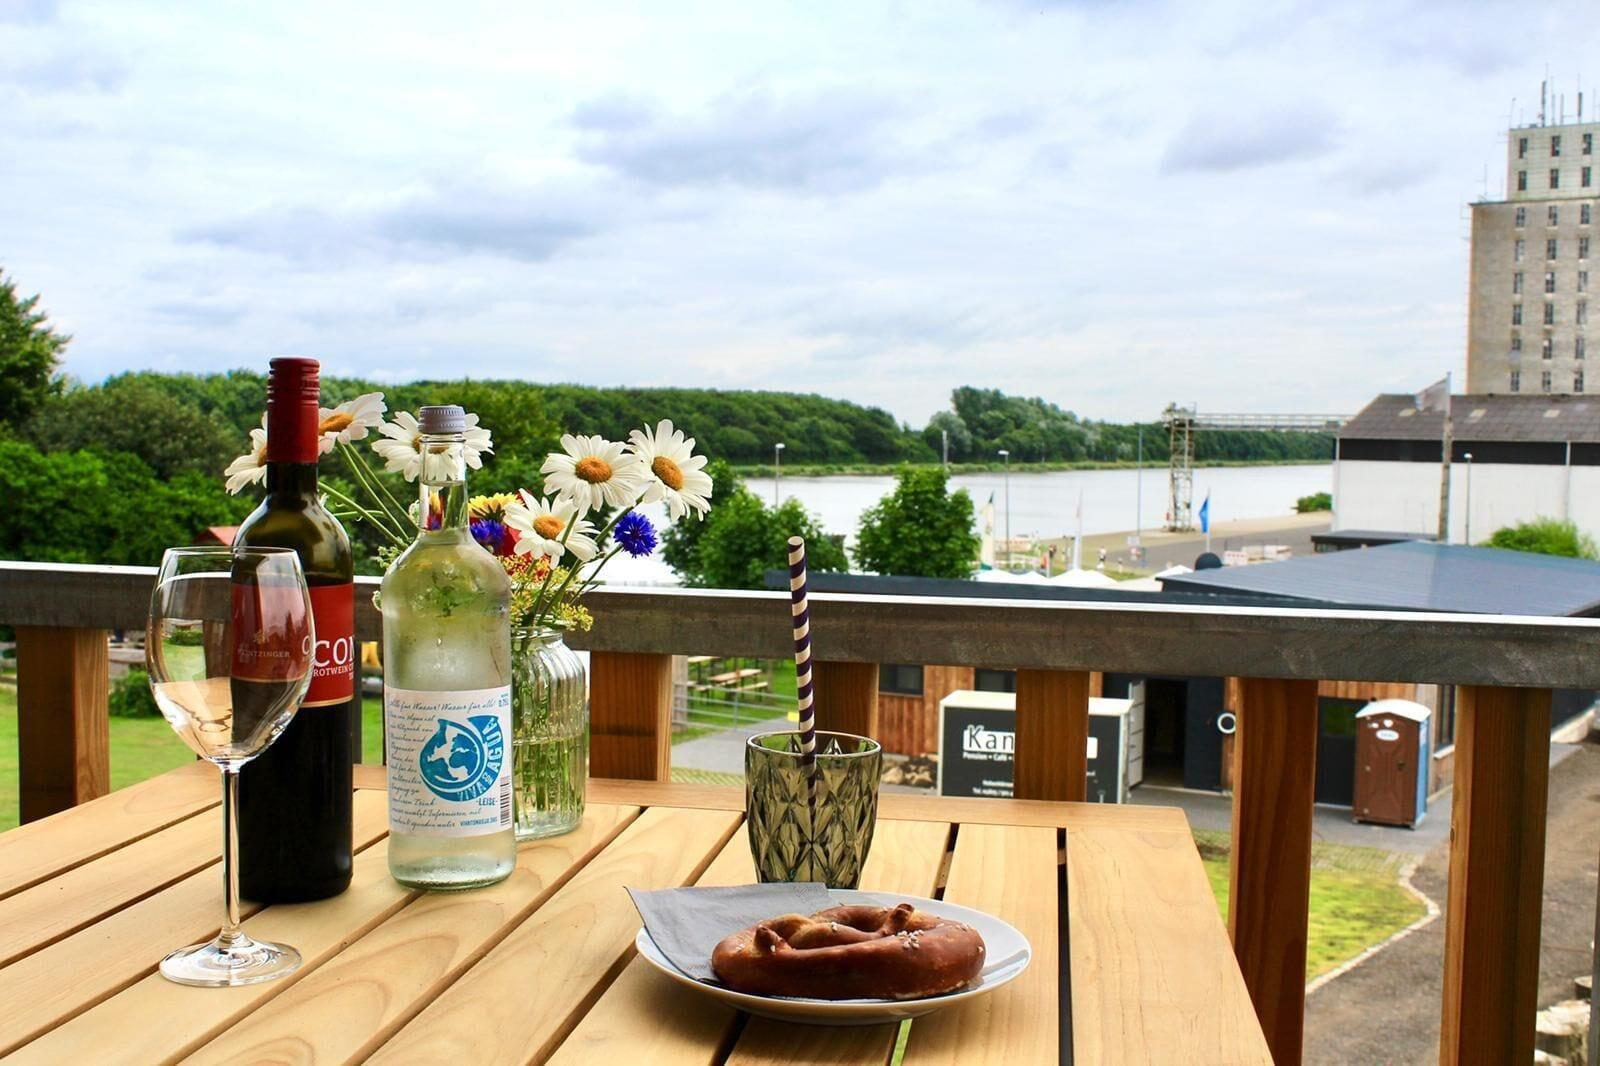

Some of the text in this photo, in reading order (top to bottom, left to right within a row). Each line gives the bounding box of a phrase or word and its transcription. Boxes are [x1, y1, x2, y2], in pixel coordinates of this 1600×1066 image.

[237, 648, 290, 658] NTZINGER
[313, 665, 349, 677] ROTWEIN
[456, 781, 486, 801] VIVA
[482, 717, 502, 773] AGUA
